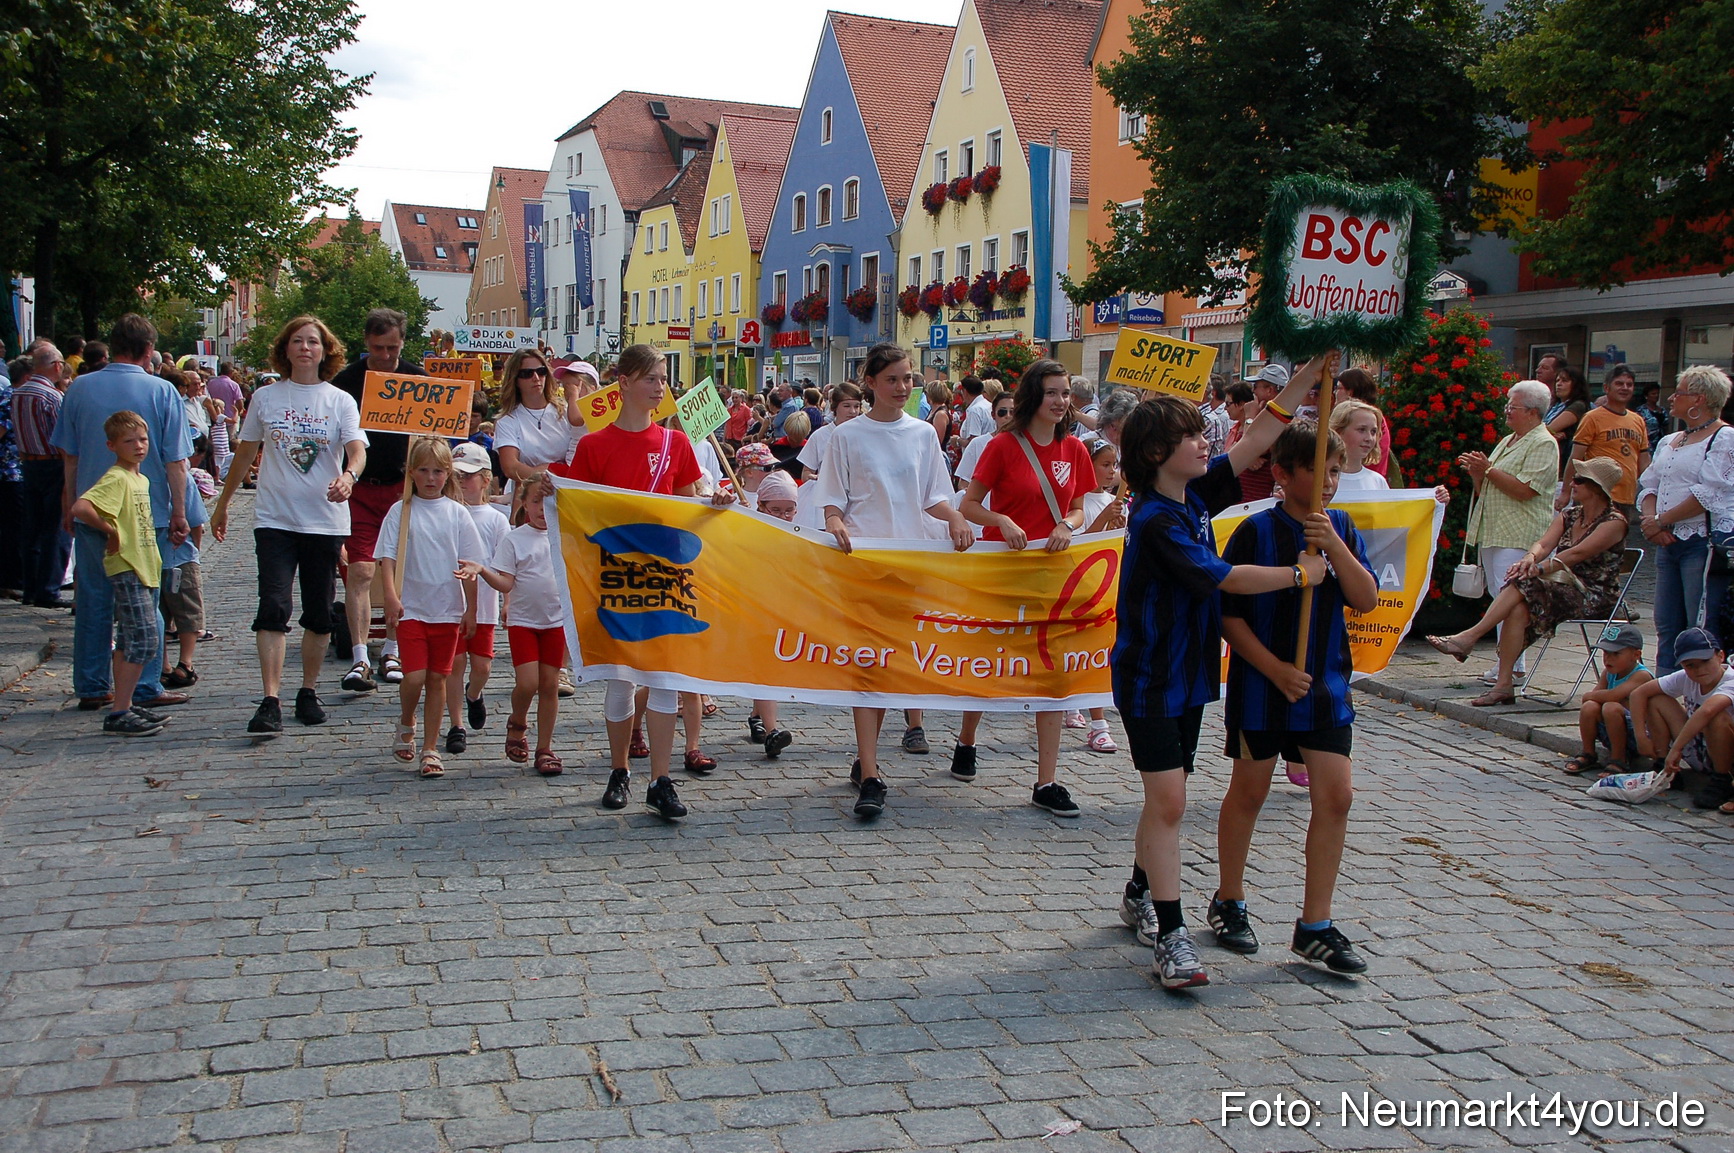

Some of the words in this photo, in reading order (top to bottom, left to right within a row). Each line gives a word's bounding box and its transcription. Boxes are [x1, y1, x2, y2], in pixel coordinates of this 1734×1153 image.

[1301, 213, 1391, 267] BSC
[652, 268, 668, 283] HOTEL
[1285, 273, 1399, 319] Woffenbach
[1129, 314, 1161, 322] Reisebüro
[482, 330, 504, 339] DJK
[934, 328, 943, 346] P
[469, 340, 516, 349] HANDBALL
[1130, 338, 1200, 368] SPORT
[429, 361, 473, 374] SPORT
[1116, 364, 1157, 383] macht
[1158, 368, 1201, 394] Freude
[378, 379, 462, 405] SPORT
[682, 385, 711, 421] SPORT
[284, 410, 325, 424] Kinder
[366, 406, 413, 426] macht
[420, 408, 469, 435] Spaß
[691, 420, 703, 443] gibt
[703, 401, 724, 428] Kraft
[299, 423, 327, 435] Turn
[1378, 598, 1403, 609] trale
[1346, 621, 1400, 635] dheitliche
[774, 628, 896, 668] Unser
[911, 641, 1030, 679] Verein
